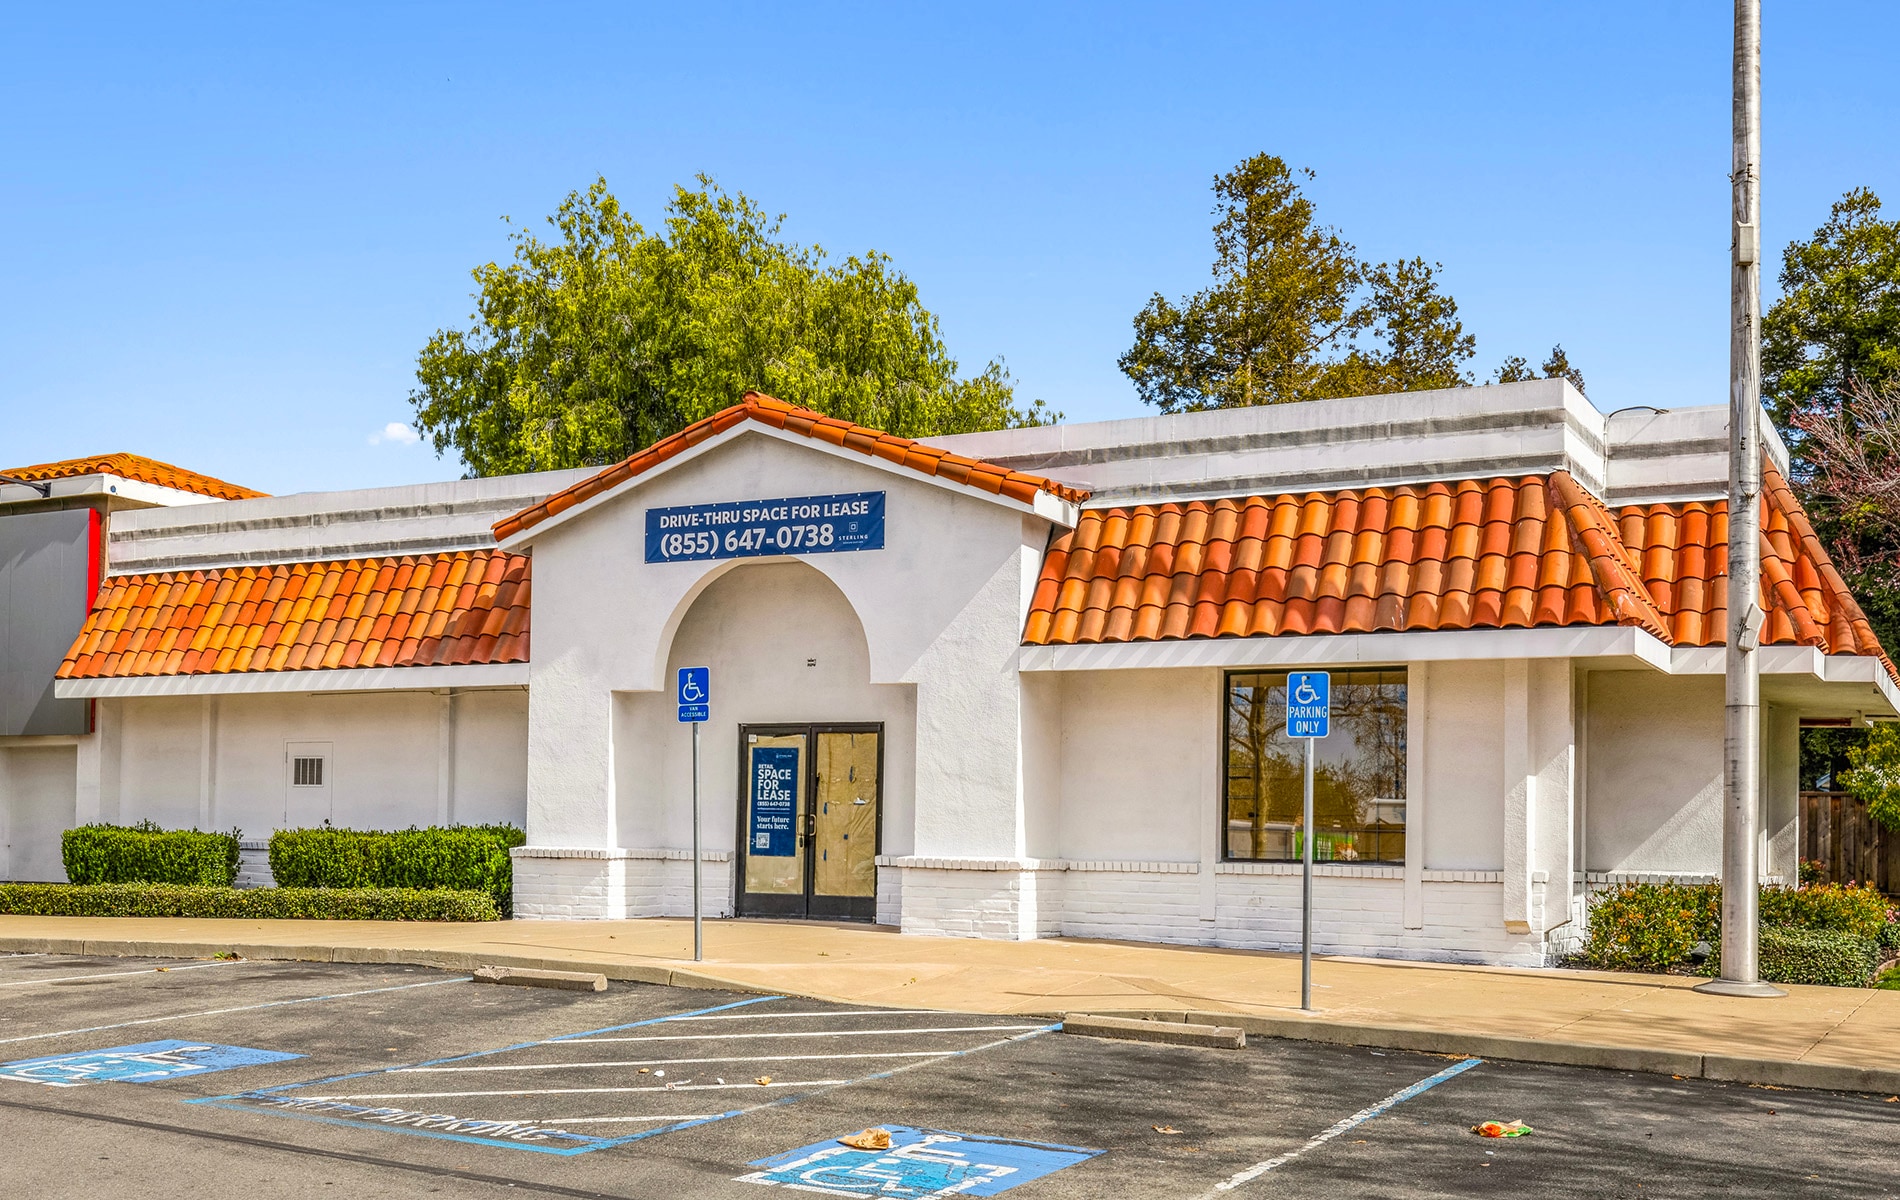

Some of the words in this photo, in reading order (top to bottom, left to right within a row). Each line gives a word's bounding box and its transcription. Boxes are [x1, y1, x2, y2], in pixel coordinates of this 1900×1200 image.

[660, 510, 740, 529] DRIVE-THRU
[742, 506, 788, 523] SPACE
[791, 504, 820, 519] FOR
[823, 500, 869, 517] LEASE
[660, 530, 719, 558] (855)
[724, 523, 834, 552] 647-0738
[1289, 705, 1328, 719] PARKING
[1296, 720, 1320, 734] ONLY
[757, 769, 792, 780] SPACE
[757, 779, 780, 790] FOR
[757, 790, 791, 801] LEASE
